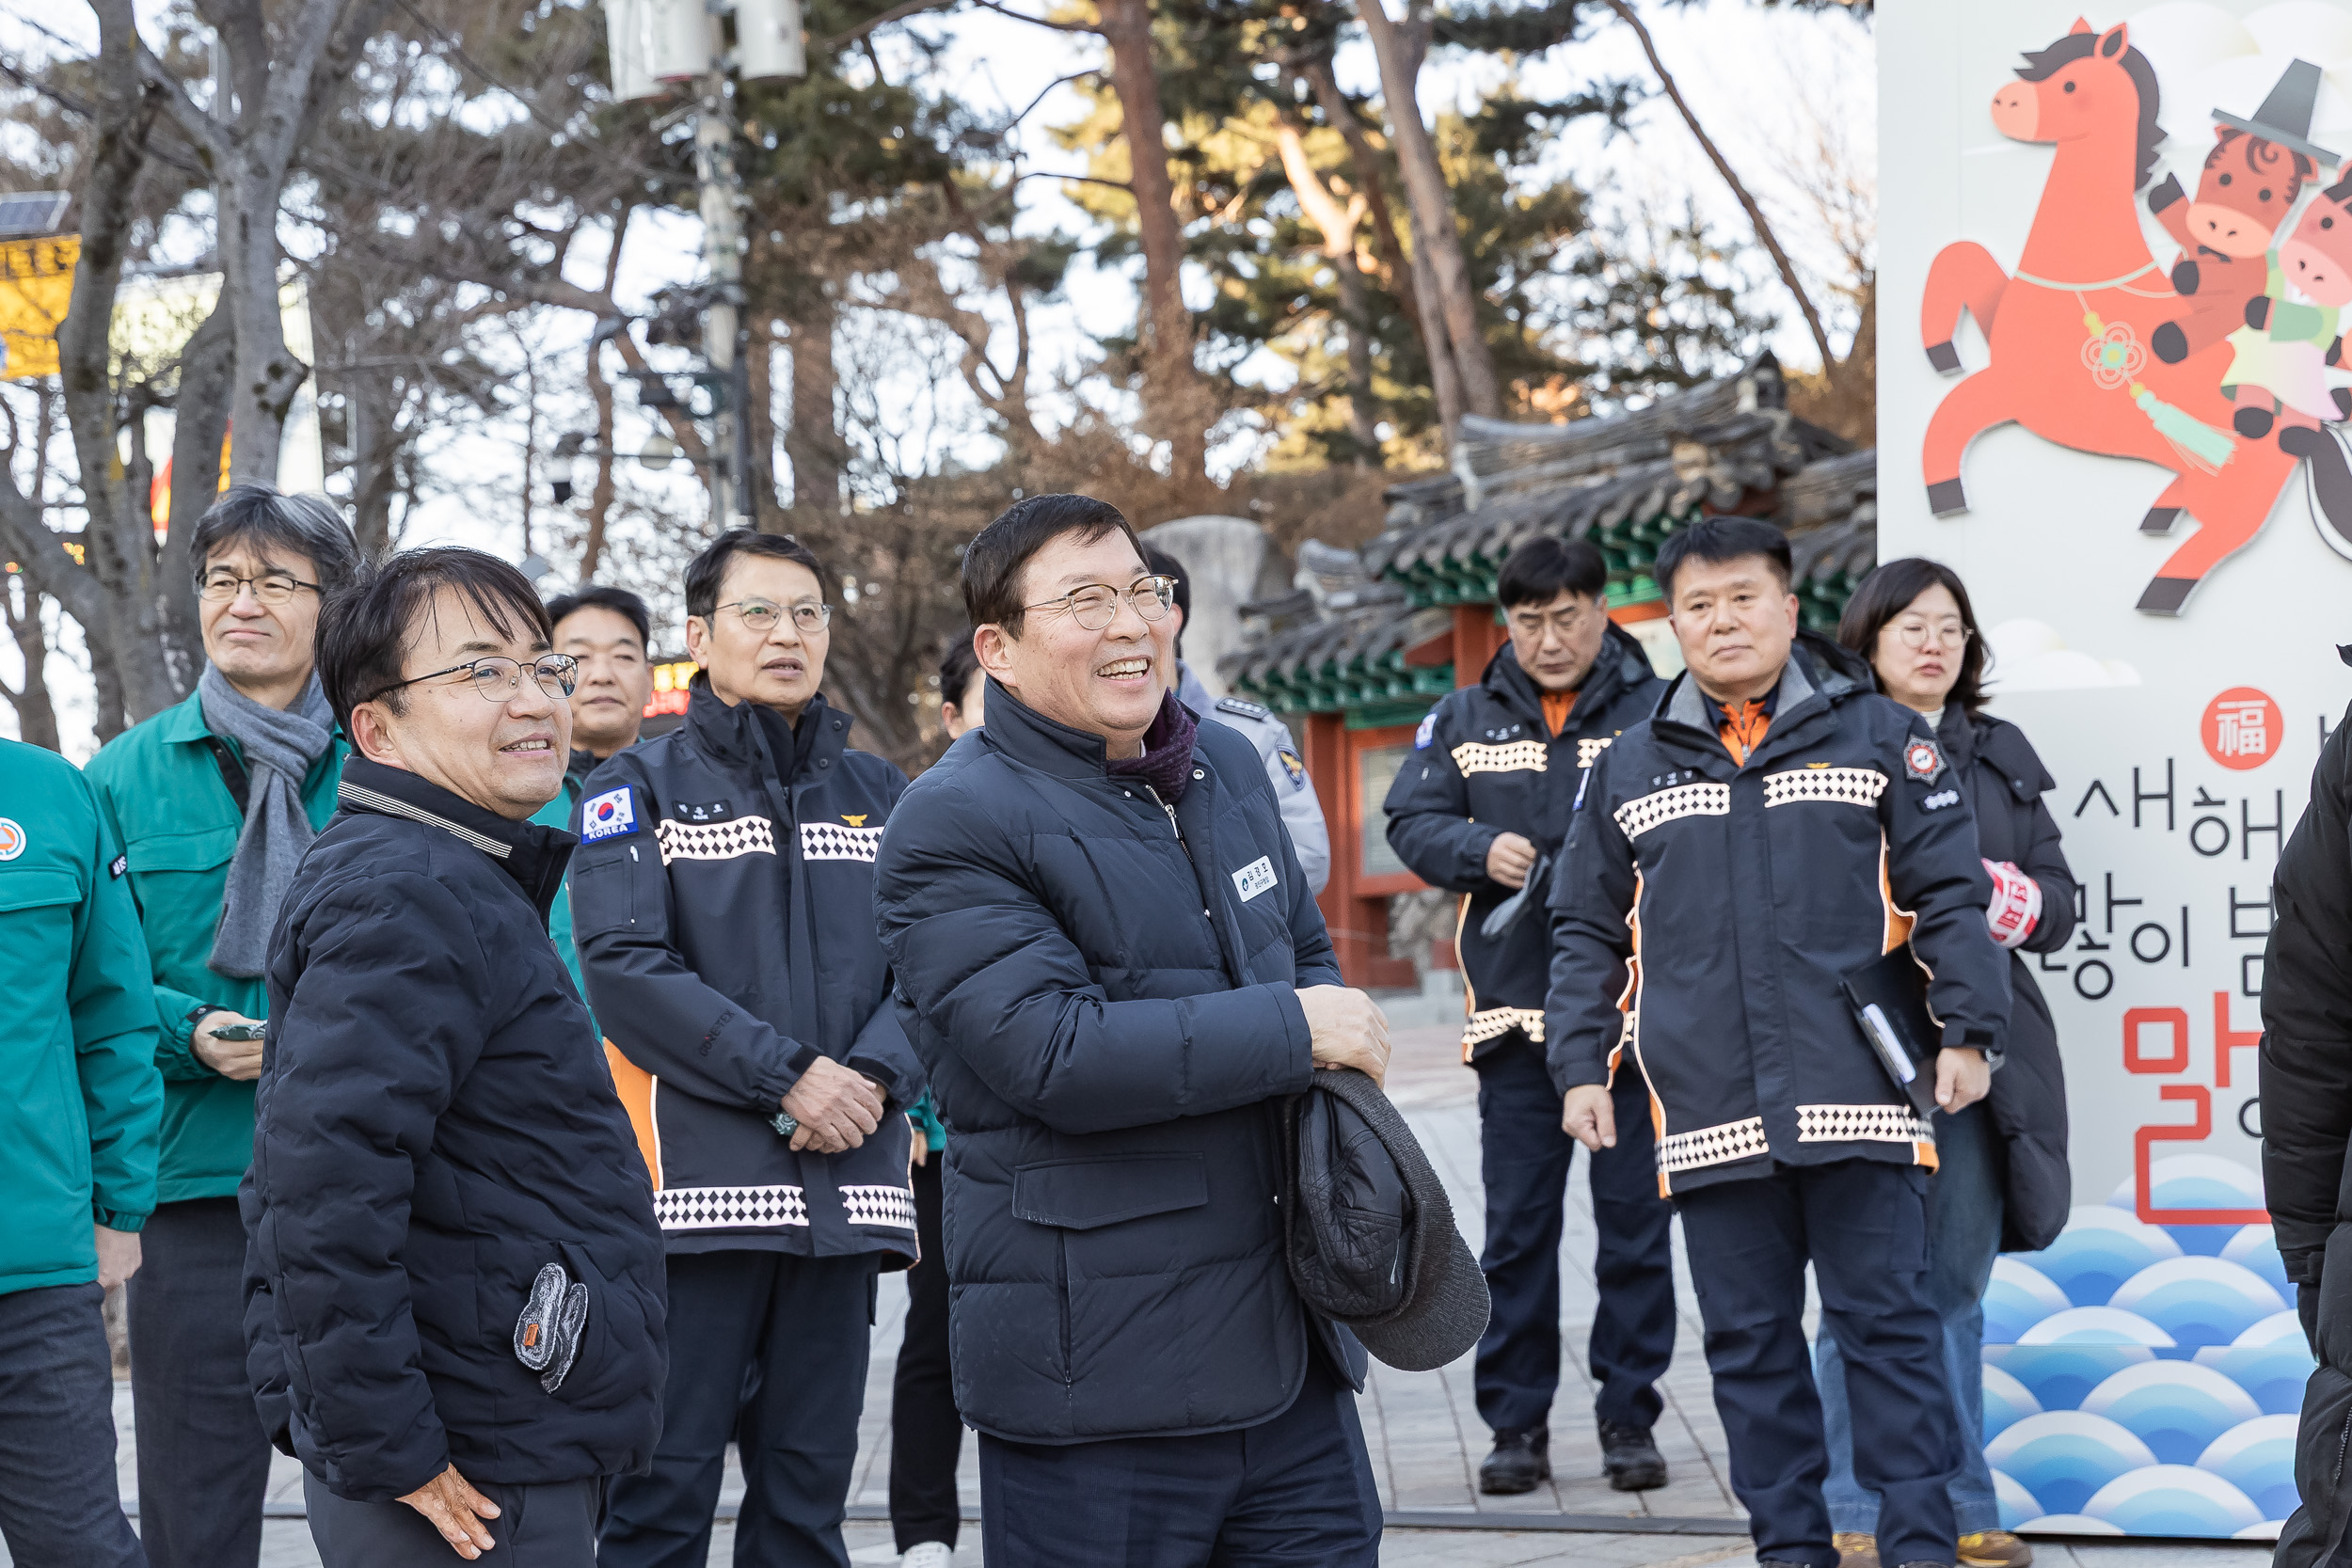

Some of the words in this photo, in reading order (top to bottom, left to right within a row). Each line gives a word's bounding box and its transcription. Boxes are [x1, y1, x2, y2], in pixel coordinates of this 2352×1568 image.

[2216, 699, 2268, 757] 福
[588, 824, 628, 840] KOREA
[2074, 758, 2282, 861] 새해
